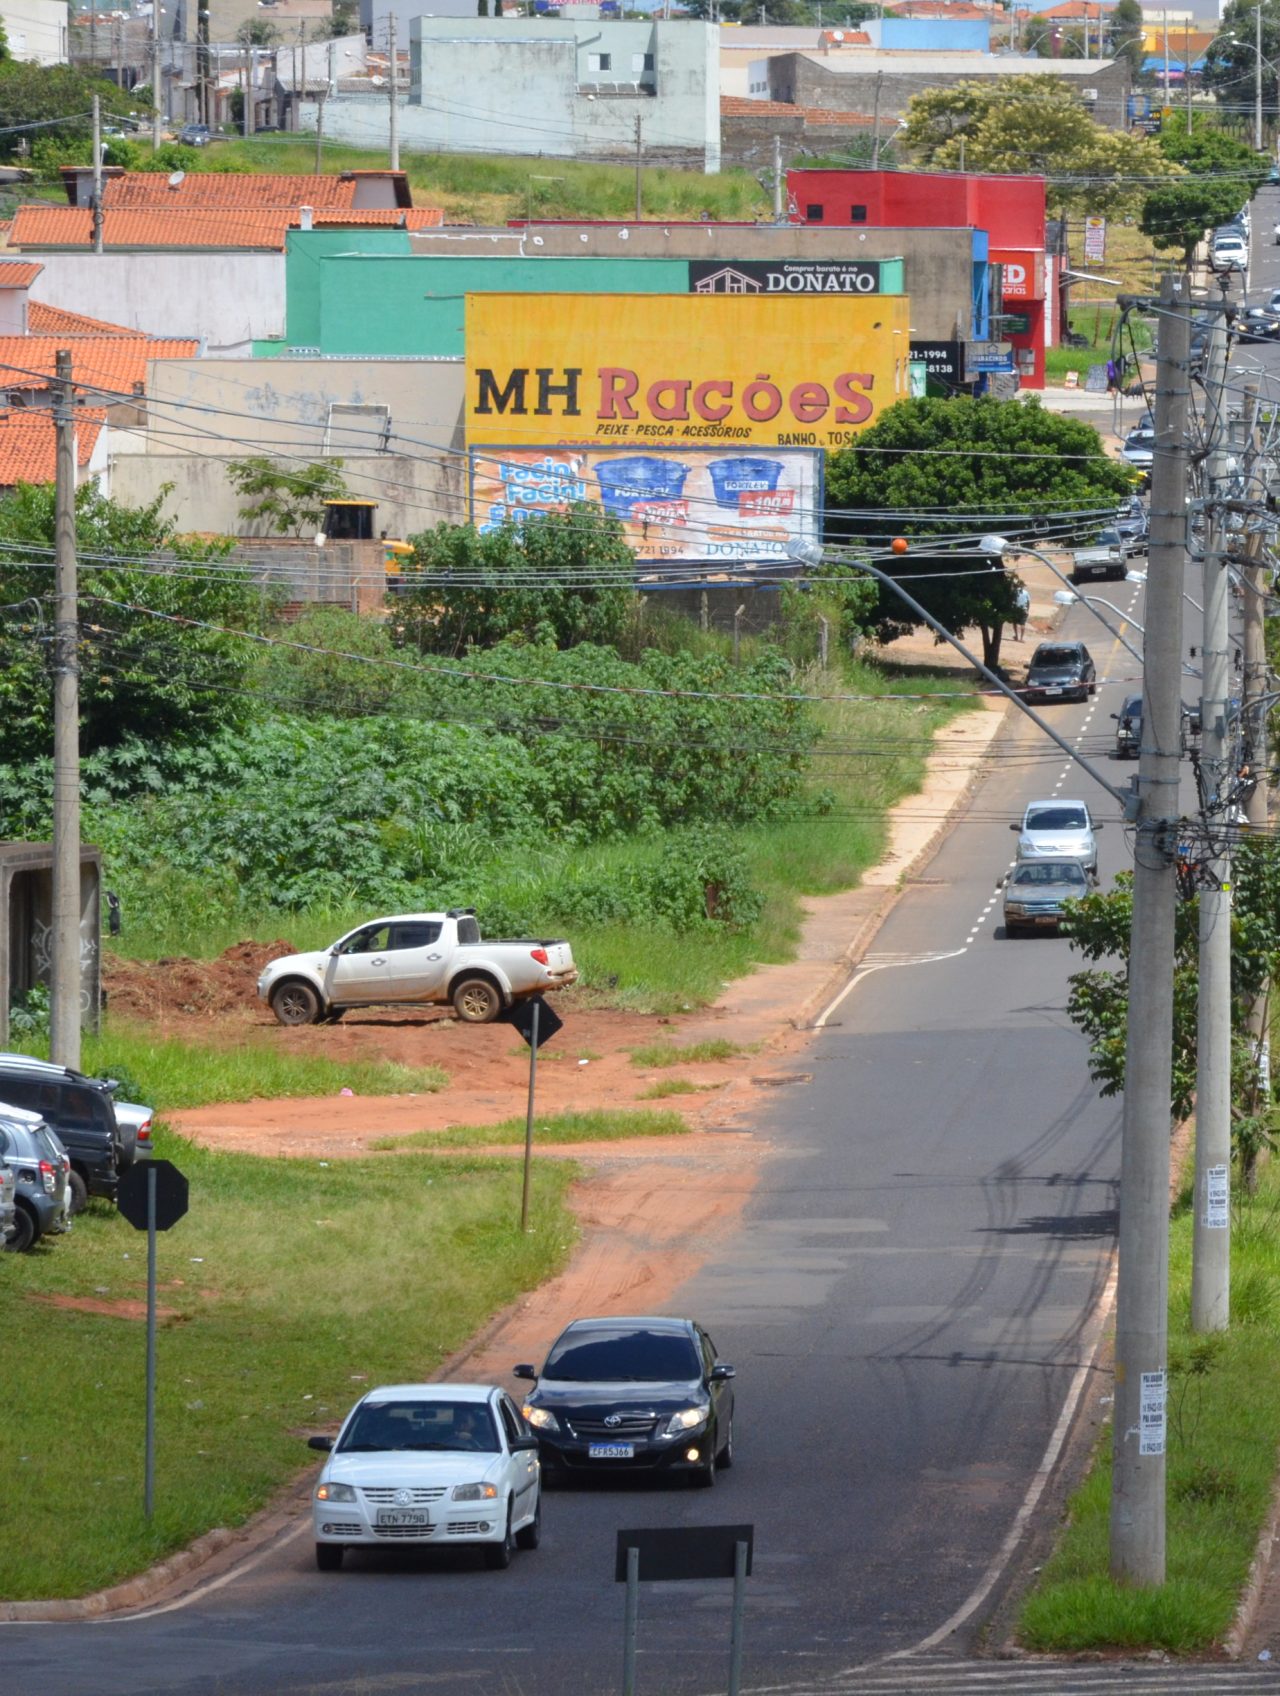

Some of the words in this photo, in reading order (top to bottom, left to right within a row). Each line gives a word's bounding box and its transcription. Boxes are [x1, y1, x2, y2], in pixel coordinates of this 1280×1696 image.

[784, 264, 814, 272] Comprar
[766, 273, 875, 292] DONATO
[474, 368, 582, 416] MH
[595, 423, 630, 435] PEIXE
[636, 424, 674, 437] PESCA
[681, 423, 752, 438] ACESSÓRIOS
[777, 431, 817, 446] BANHO
[706, 542, 785, 556] DONATO
